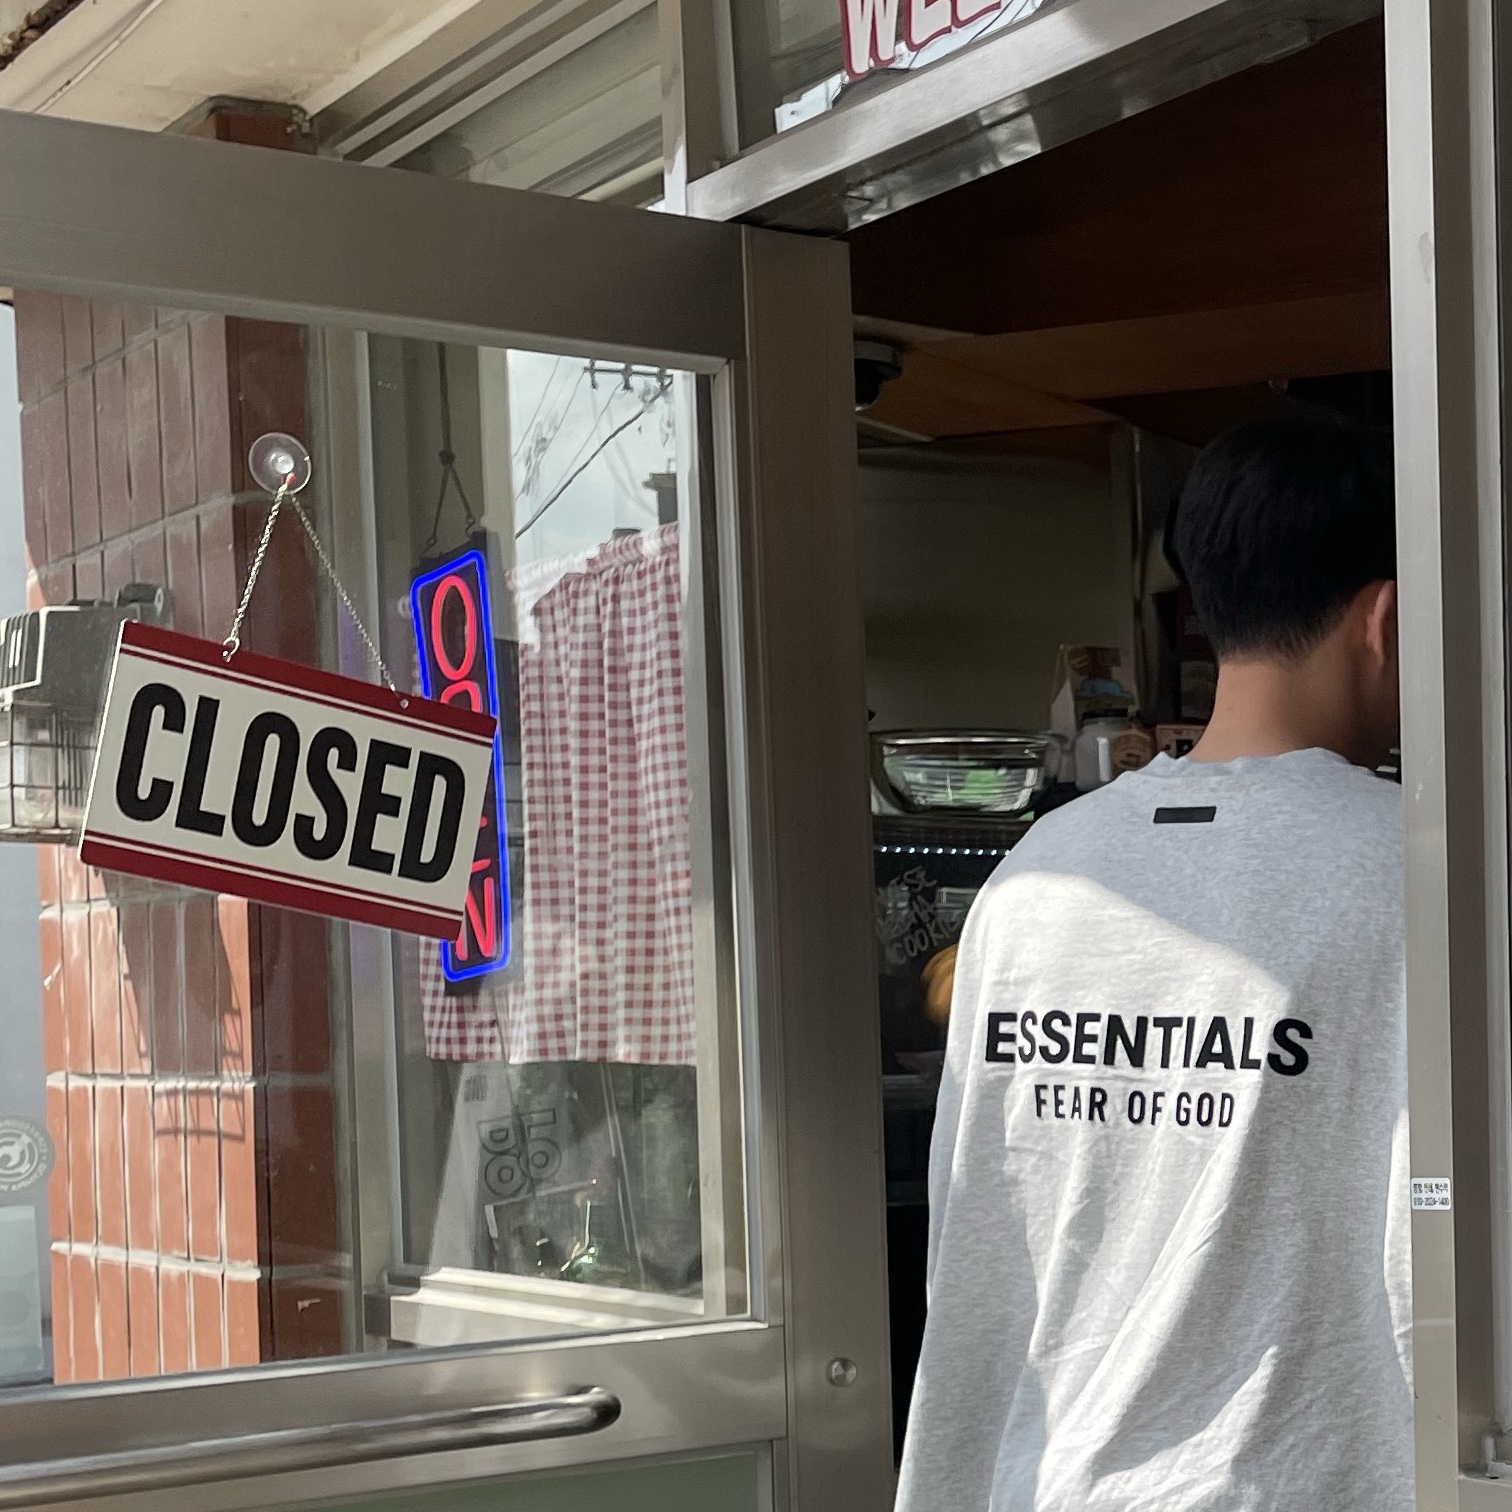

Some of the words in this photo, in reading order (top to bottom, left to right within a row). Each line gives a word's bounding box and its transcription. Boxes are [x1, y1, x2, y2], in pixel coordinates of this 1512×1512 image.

[115, 682, 466, 884] CLOSED
[985, 1009, 1314, 1077] ESSENTIALS
[1033, 1084, 1108, 1123] FEAR
[1127, 1089, 1166, 1126] OF
[1175, 1090, 1236, 1128] GOD
